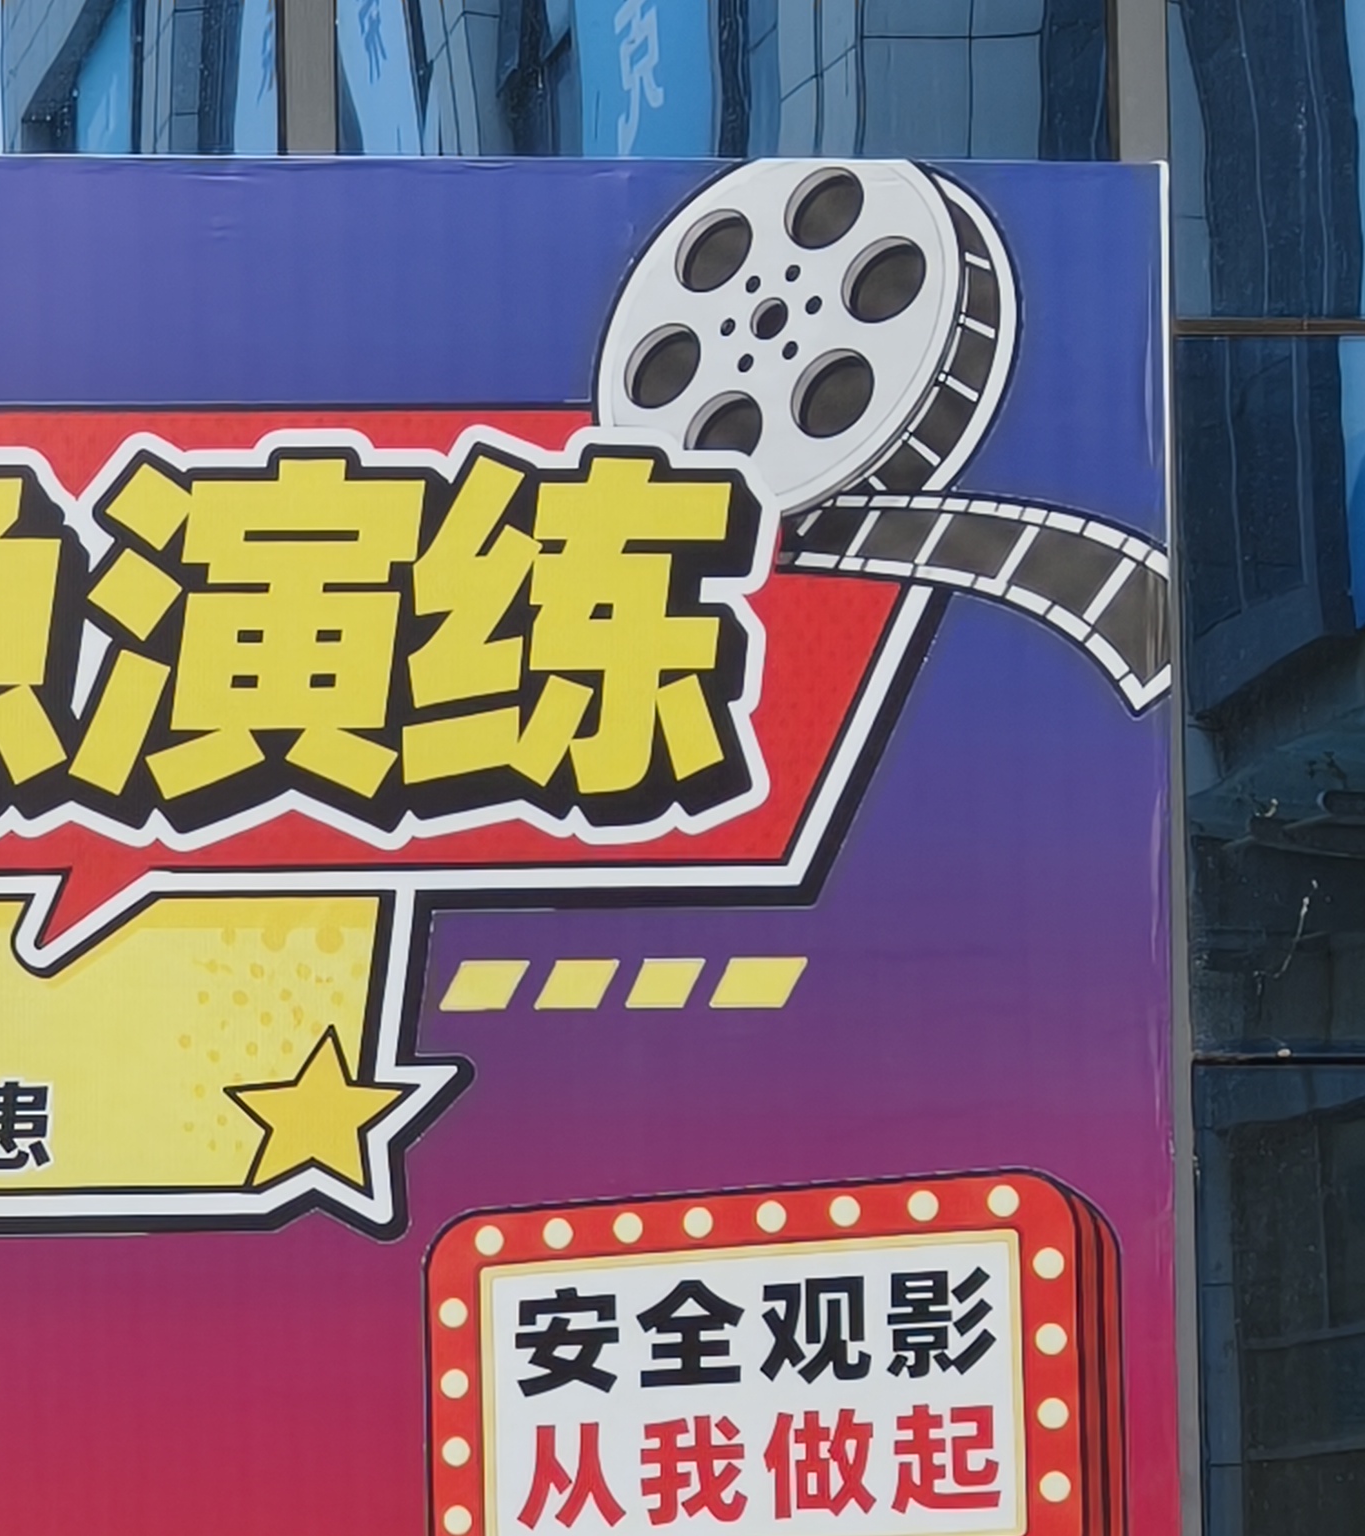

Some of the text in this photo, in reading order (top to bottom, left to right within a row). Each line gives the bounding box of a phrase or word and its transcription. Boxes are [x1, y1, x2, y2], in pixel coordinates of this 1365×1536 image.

[515, 1266, 996, 1397] 安全观影
[517, 1403, 1000, 1530] 从我做起
